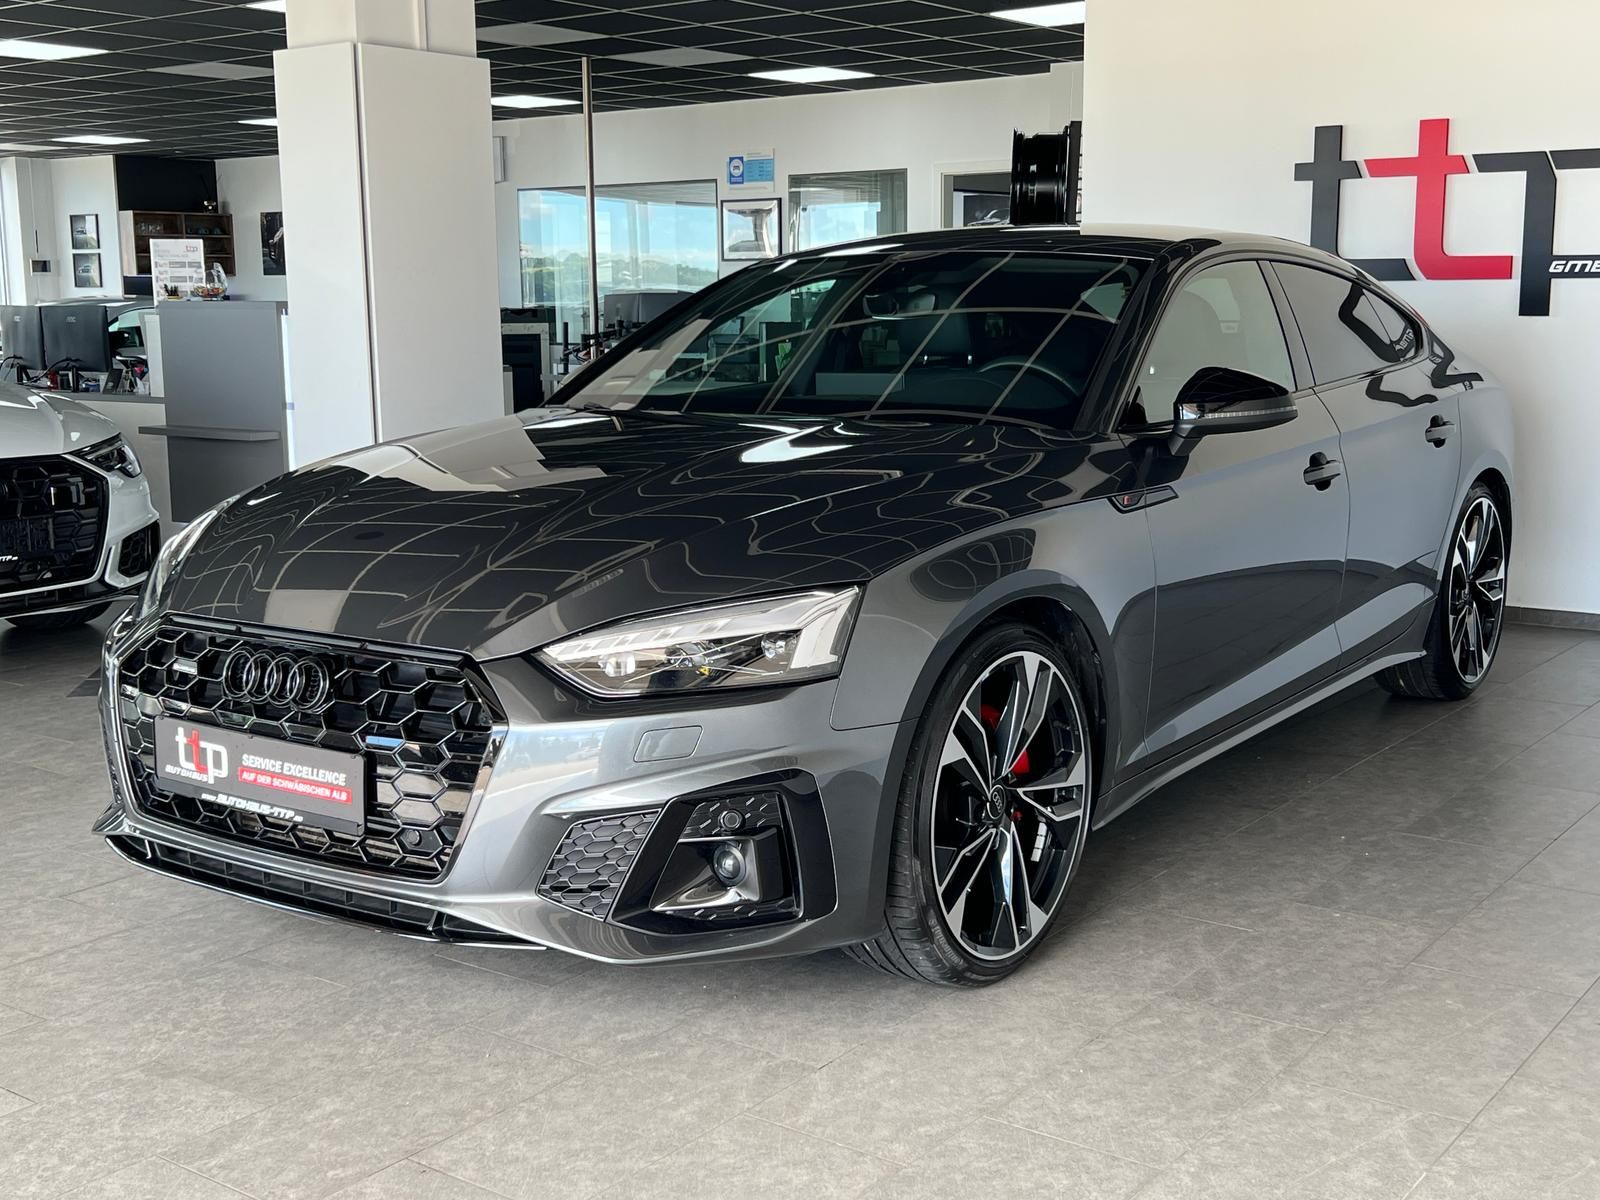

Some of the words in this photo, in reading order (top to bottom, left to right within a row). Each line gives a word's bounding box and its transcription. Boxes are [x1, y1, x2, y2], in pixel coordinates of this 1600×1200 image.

[175, 727, 228, 784] ttp
[242, 753, 282, 773] SERVICE
[283, 762, 347, 786] EXCELLENCE
[242, 771, 256, 781] AUF
[257, 774, 272, 785] DER
[331, 790, 348, 801] ALB
